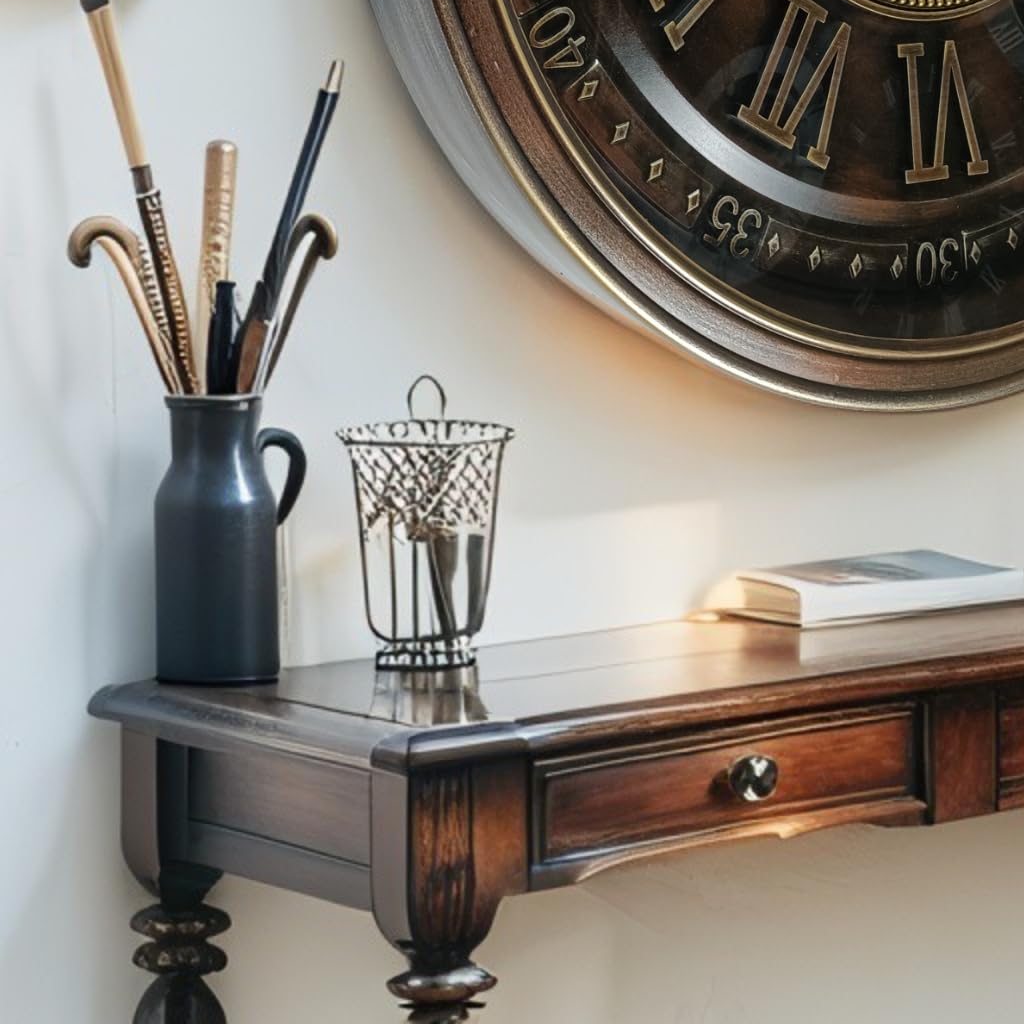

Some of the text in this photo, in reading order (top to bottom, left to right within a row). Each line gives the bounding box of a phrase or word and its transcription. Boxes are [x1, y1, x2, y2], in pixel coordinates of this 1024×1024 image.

[529, 6, 587, 70] 40
[897, 40, 989, 184] VI
[703, 195, 762, 257] 35
[916, 238, 960, 287] 30
